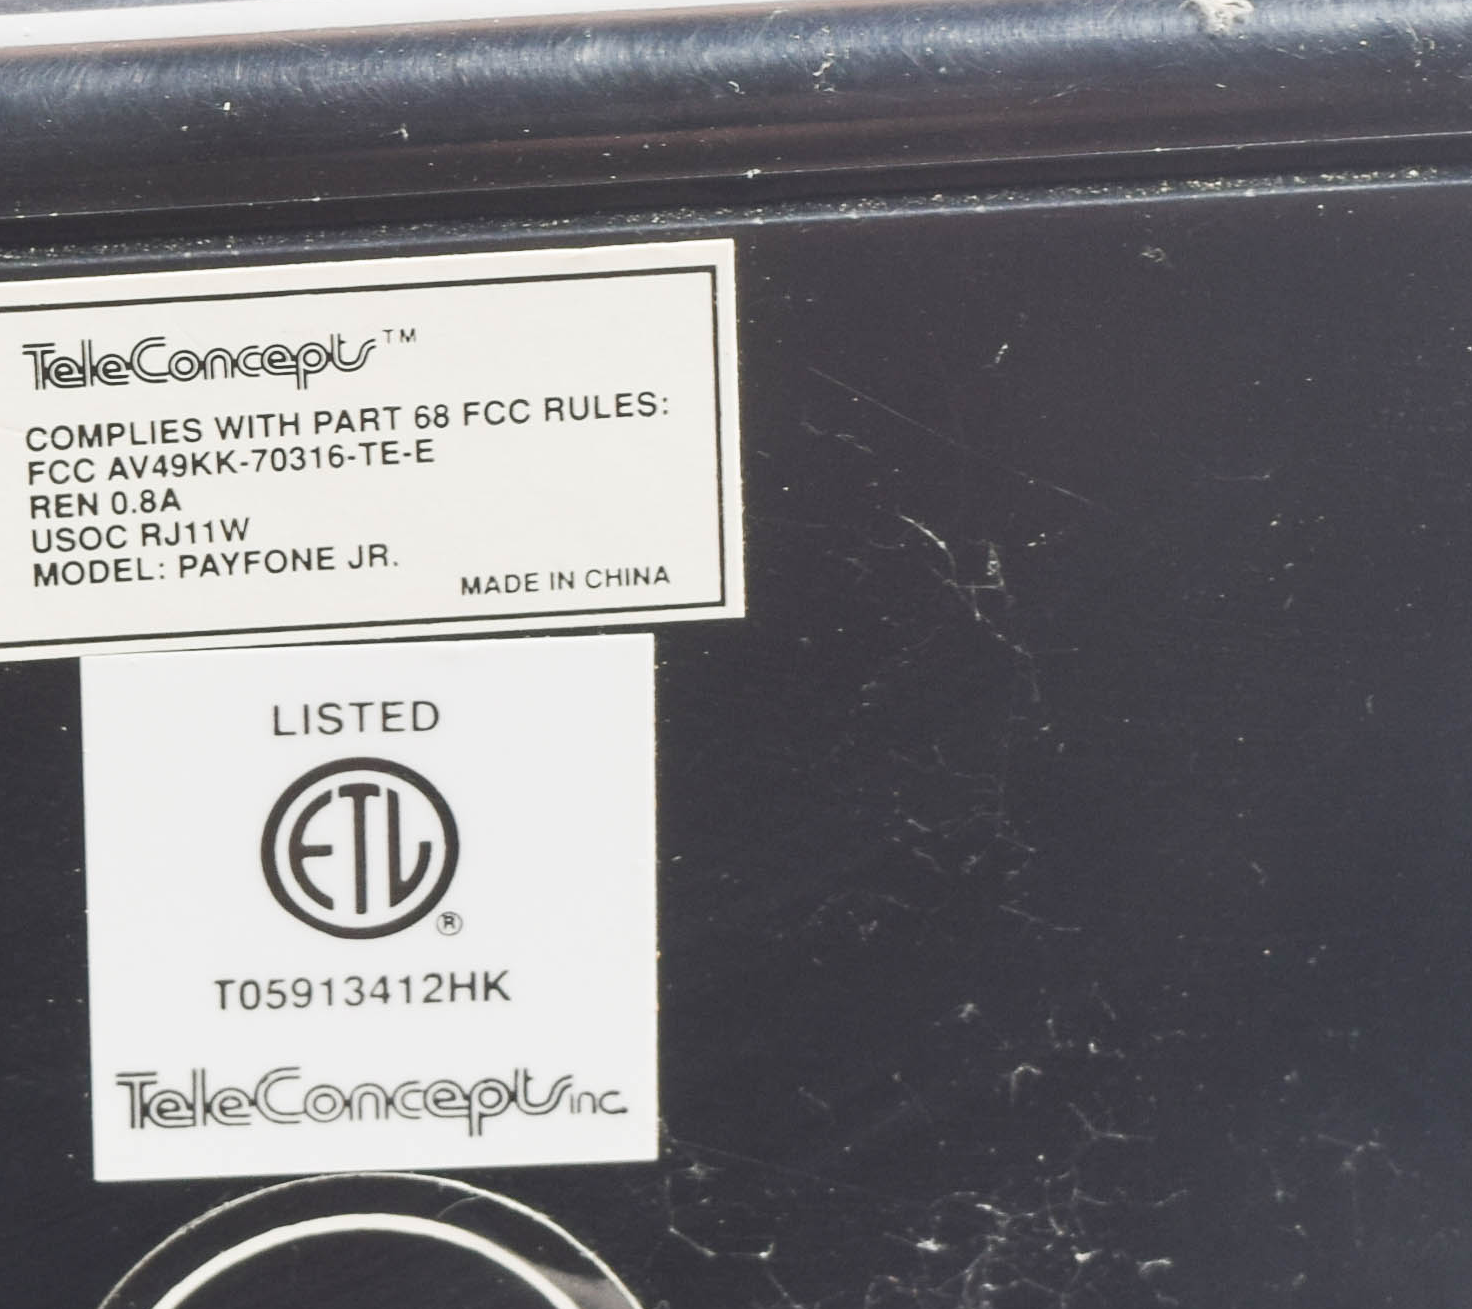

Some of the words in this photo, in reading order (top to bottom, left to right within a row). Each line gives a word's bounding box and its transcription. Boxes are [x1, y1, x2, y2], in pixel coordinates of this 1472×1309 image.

[25, 417, 203, 452] COMPLIES
[214, 412, 300, 441] WITH
[314, 406, 402, 435] PART
[414, 403, 450, 430] 68
[463, 398, 530, 426] FCC
[544, 391, 668, 422] RULES:
[28, 458, 95, 486] FCC
[108, 439, 434, 481] AV49KK-70316-TE-E
[29, 492, 98, 520] REN
[111, 487, 182, 515] 0.8A
[32, 524, 127, 554] USOC
[141, 517, 250, 547] RJ11W
[33, 557, 165, 588] MODEL:
[179, 546, 335, 579] PAYFONE
[347, 543, 399, 570] JR.
[461, 572, 539, 596] MADE
[550, 571, 575, 590] IN
[585, 565, 670, 589] CHINA
[273, 700, 440, 736] LISTED
[214, 970, 511, 1011] T05913412HK
